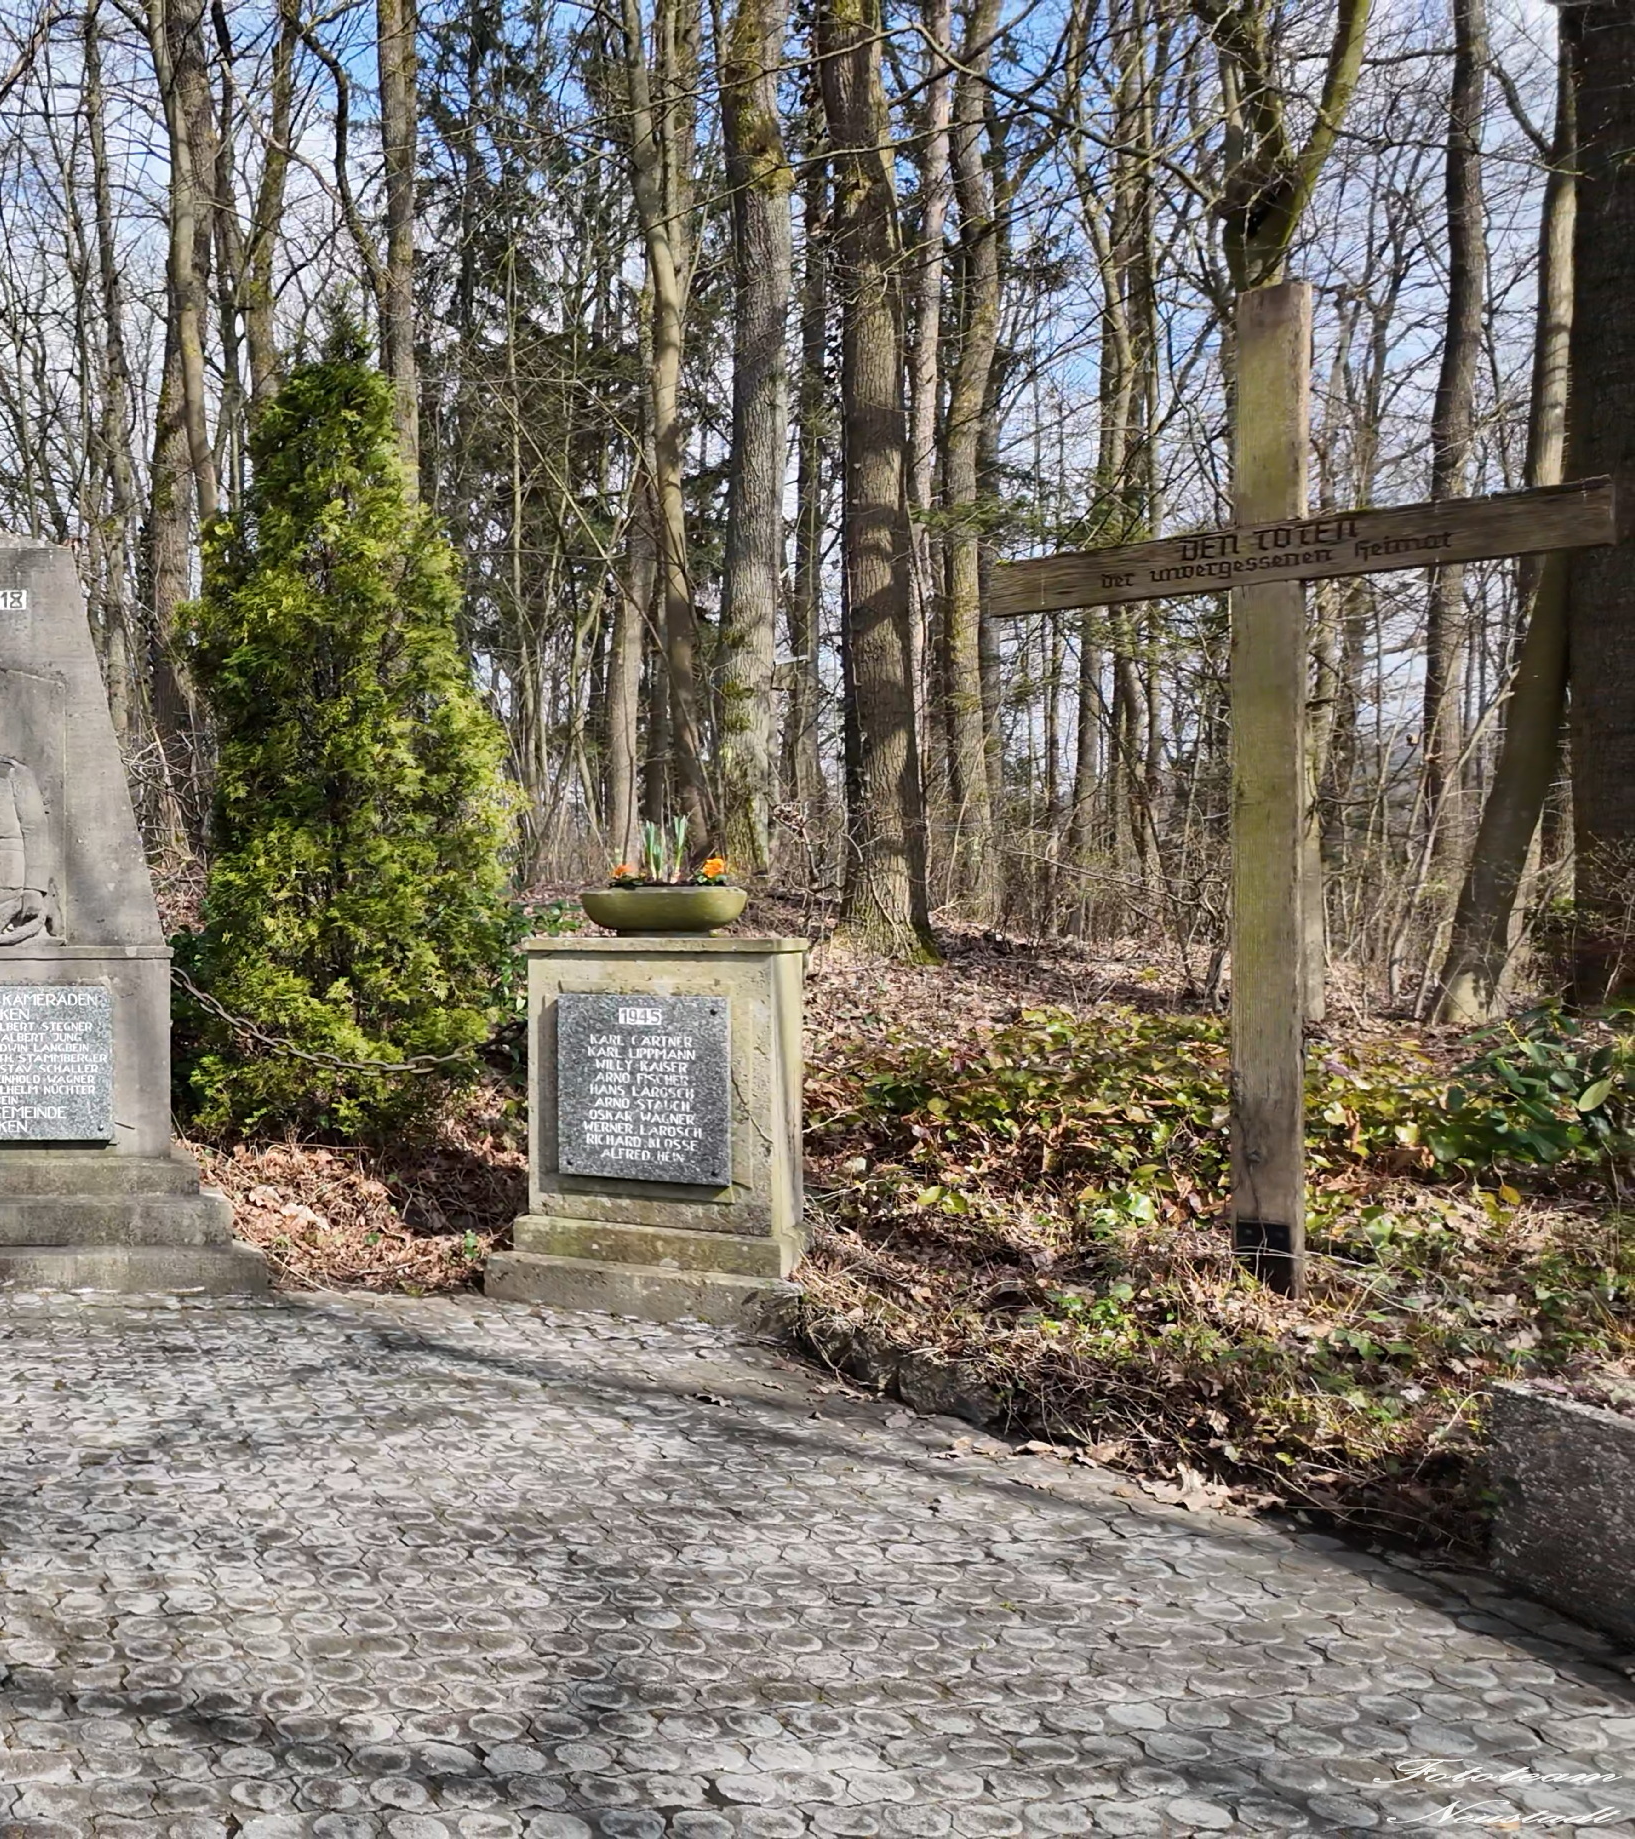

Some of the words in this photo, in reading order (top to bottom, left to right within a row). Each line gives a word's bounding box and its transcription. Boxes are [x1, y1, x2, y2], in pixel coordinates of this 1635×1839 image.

[1179, 533, 1240, 561] DEN
[1253, 520, 1357, 551] TOTEN
[1101, 572, 1135, 588] der
[2, 993, 97, 1006] KAMERADEN
[621, 1009, 661, 1024] 1945
[41, 1022, 93, 1032] STEGNER
[0, 1033, 45, 1042] ALBERT
[53, 1033, 83, 1042] JUNG
[589, 1034, 624, 1046] KARL
[33, 1043, 89, 1053] LANGBEIN
[587, 1046, 622, 1057] KARL
[628, 1048, 696, 1060] LIPPMANN
[18, 1054, 108, 1063] STAMMBERGER
[38, 1064, 99, 1074] SCHALLER
[595, 1059, 632, 1072] WILLY
[639, 1060, 688, 1073] KAISER
[47, 1074, 95, 1084] WAGNER
[595, 1072, 630, 1083] ARNO
[589, 1084, 625, 1095] HANS
[594, 1097, 630, 1109] ARNO
[640, 1111, 695, 1125] WAGNER
[583, 1121, 634, 1134] WERNER
[640, 1124, 703, 1139] LAROSCH
[586, 1133, 641, 1147] RICHARD
[600, 1148, 651, 1161] ALFRED
